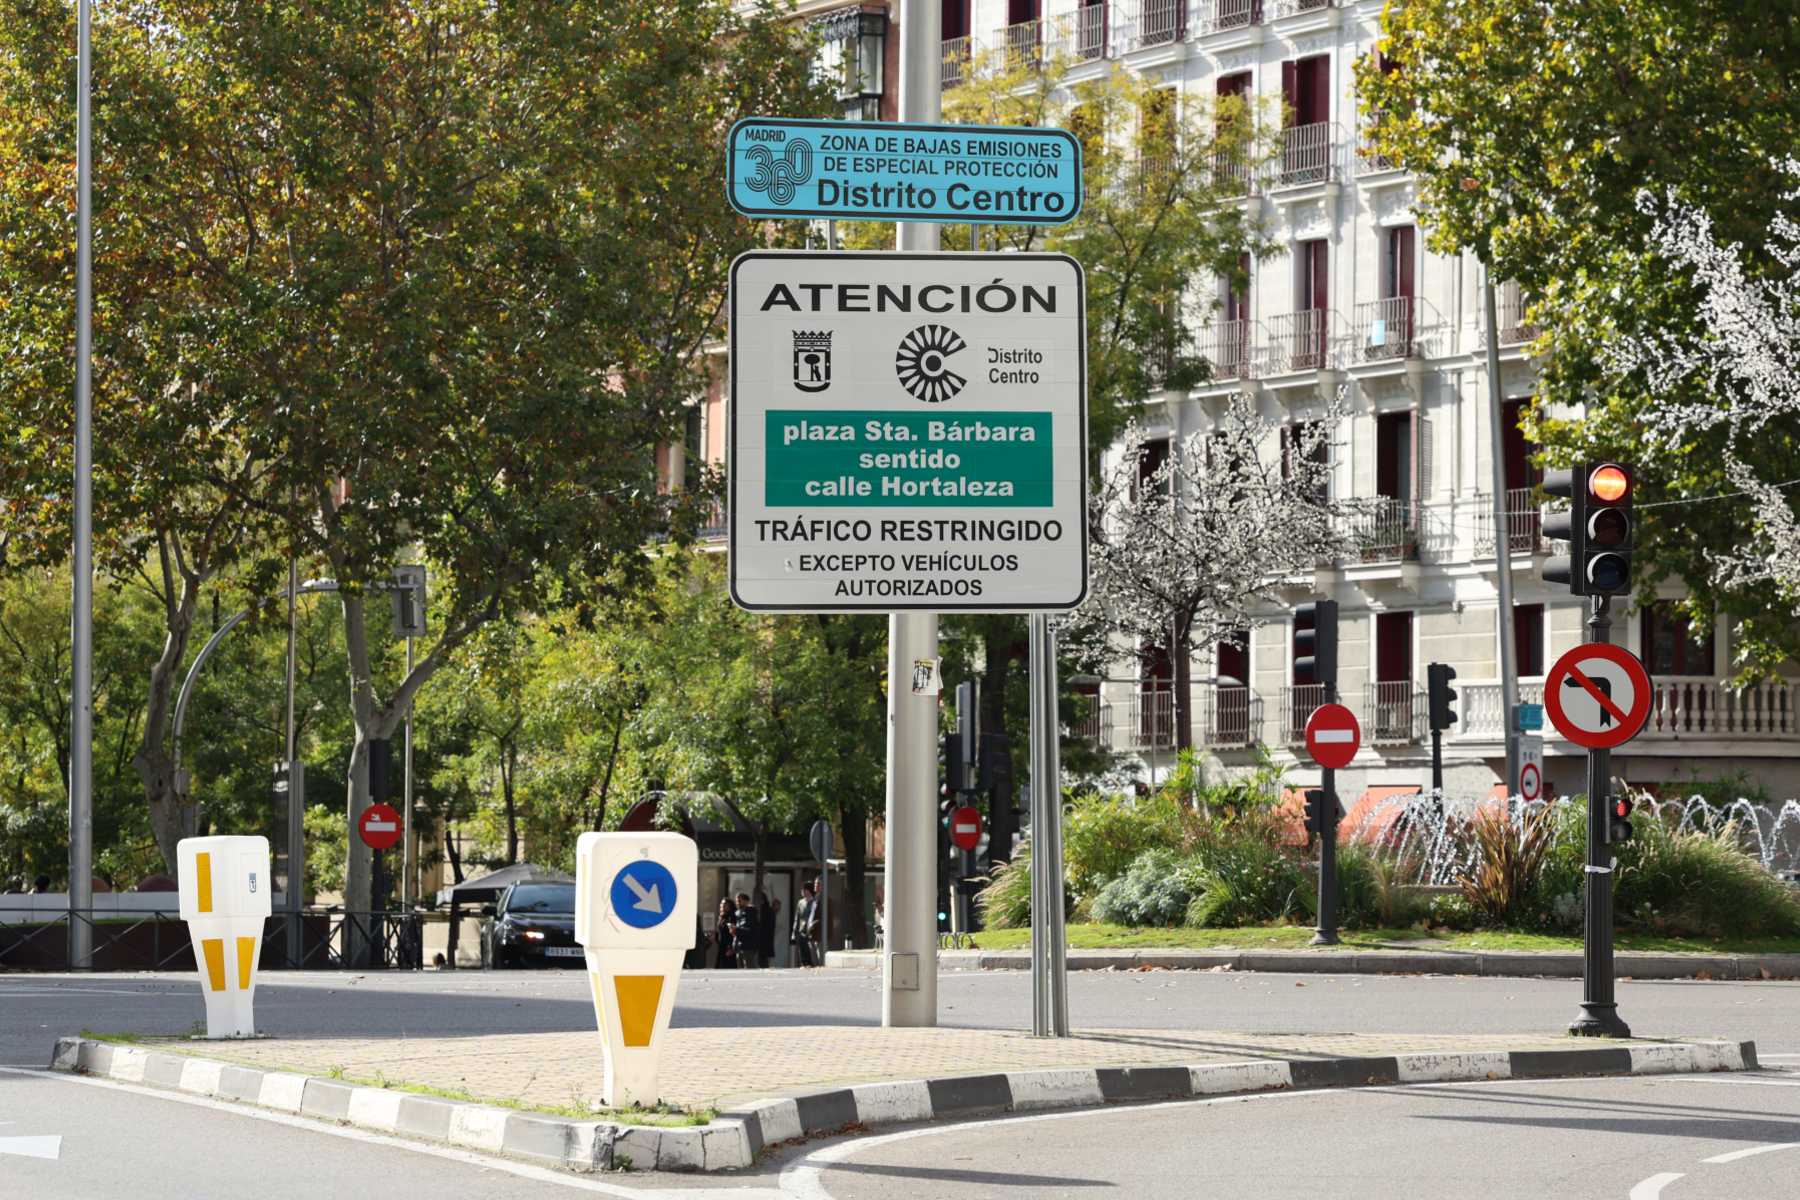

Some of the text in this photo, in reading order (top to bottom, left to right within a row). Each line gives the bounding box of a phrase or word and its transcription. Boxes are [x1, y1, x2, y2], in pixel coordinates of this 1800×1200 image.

[745, 128, 786, 142] MADRID
[820, 135, 1062, 158] ZONA DE BAJAS EMISIONES
[824, 157, 1058, 178] DE ESPECIAL PROTECCIÓN
[818, 179, 1064, 212] Distrito Centro
[760, 278, 1056, 313] ATENCIÓN
[988, 347, 1042, 364] Distrito
[989, 368, 1039, 384] Centro
[784, 421, 1035, 444] plaza Sta. Bárbara
[859, 449, 960, 469] sentido
[805, 476, 1014, 497] calle Hortaleza
[755, 515, 1063, 542] TRÁFICO RESTRINGIDO
[800, 551, 1019, 572] EXCEPTO VEHÍCULOS
[835, 580, 982, 596] AUTORIZADOS
